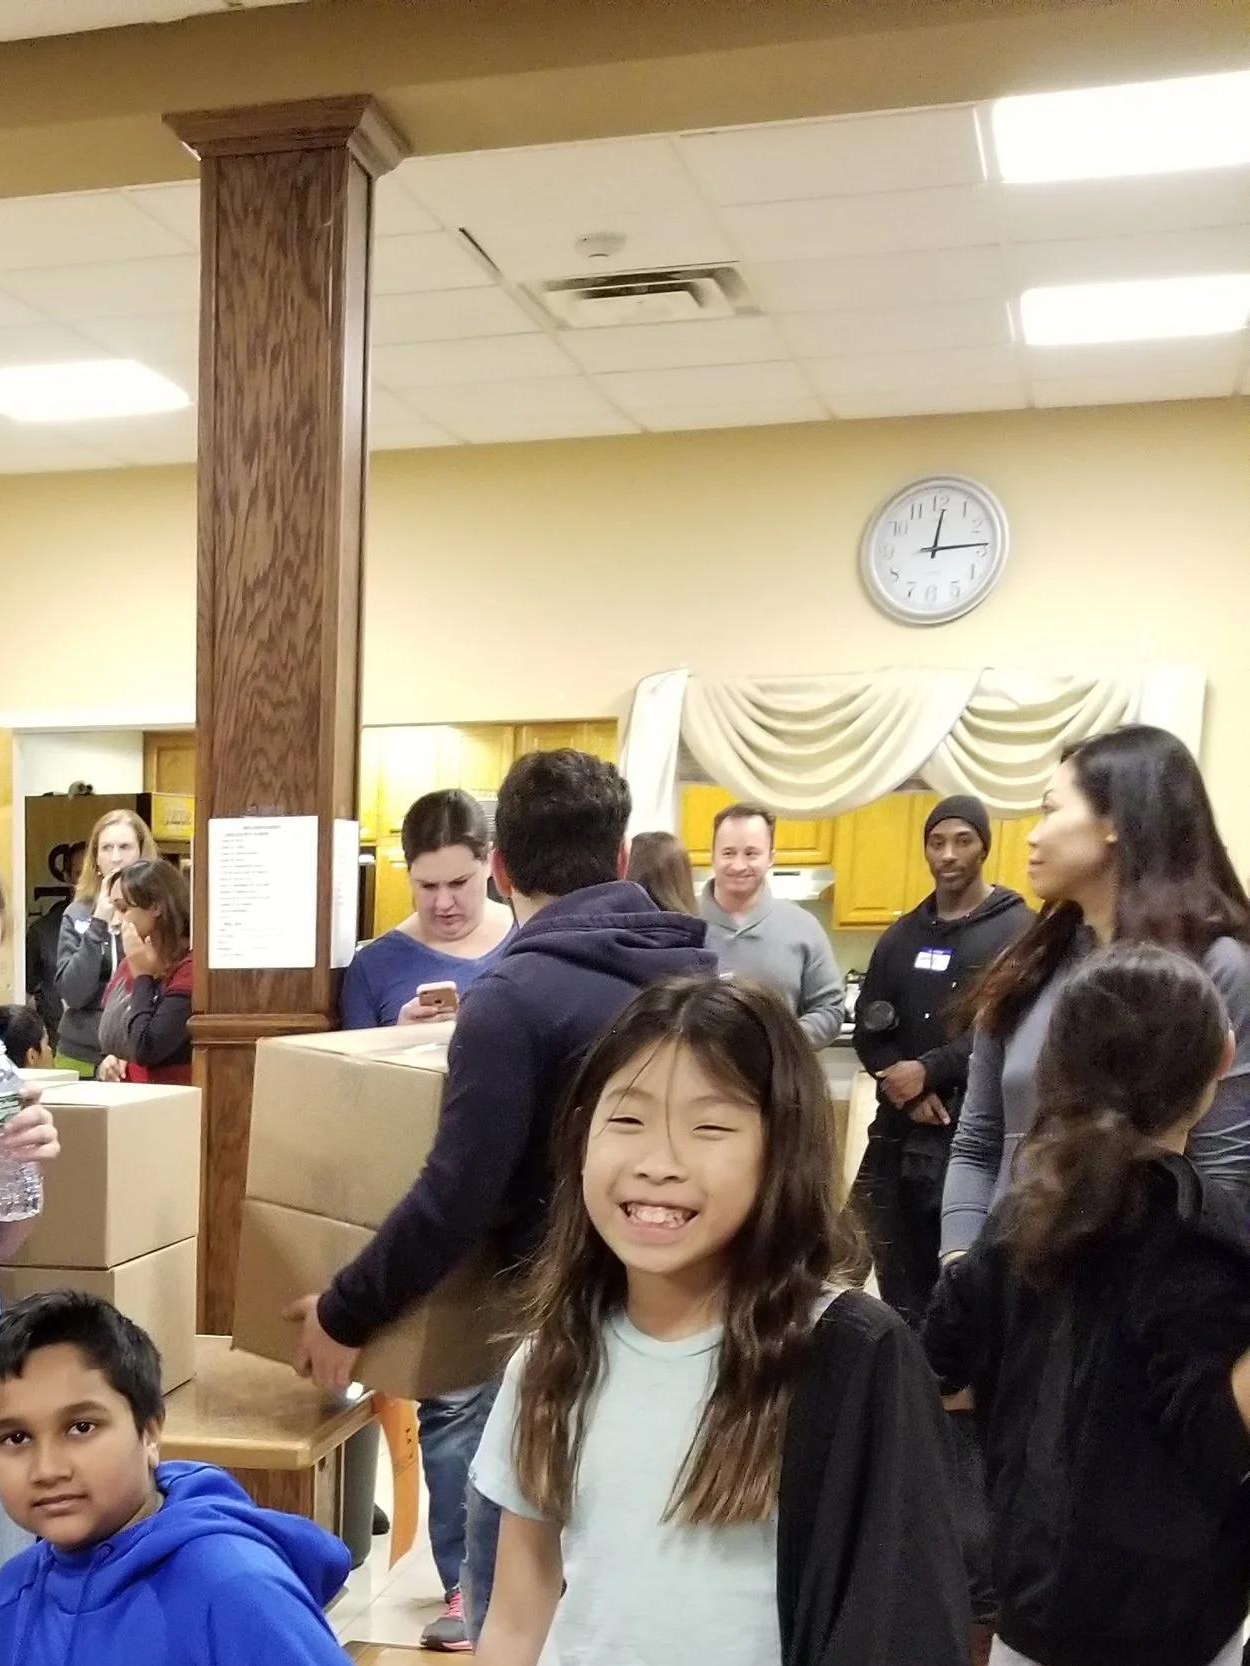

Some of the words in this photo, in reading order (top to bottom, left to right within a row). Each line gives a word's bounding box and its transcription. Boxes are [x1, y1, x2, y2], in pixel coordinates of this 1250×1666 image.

[910, 503, 923, 520] 11
[933, 495, 950, 511] 12
[887, 520, 909, 537] 10
[971, 519, 983, 534] 2
[883, 542, 895, 560] 9
[976, 542, 989, 558] 3
[906, 581, 917, 598] 7
[925, 584, 938, 602] 6
[951, 580, 961, 598] 5
